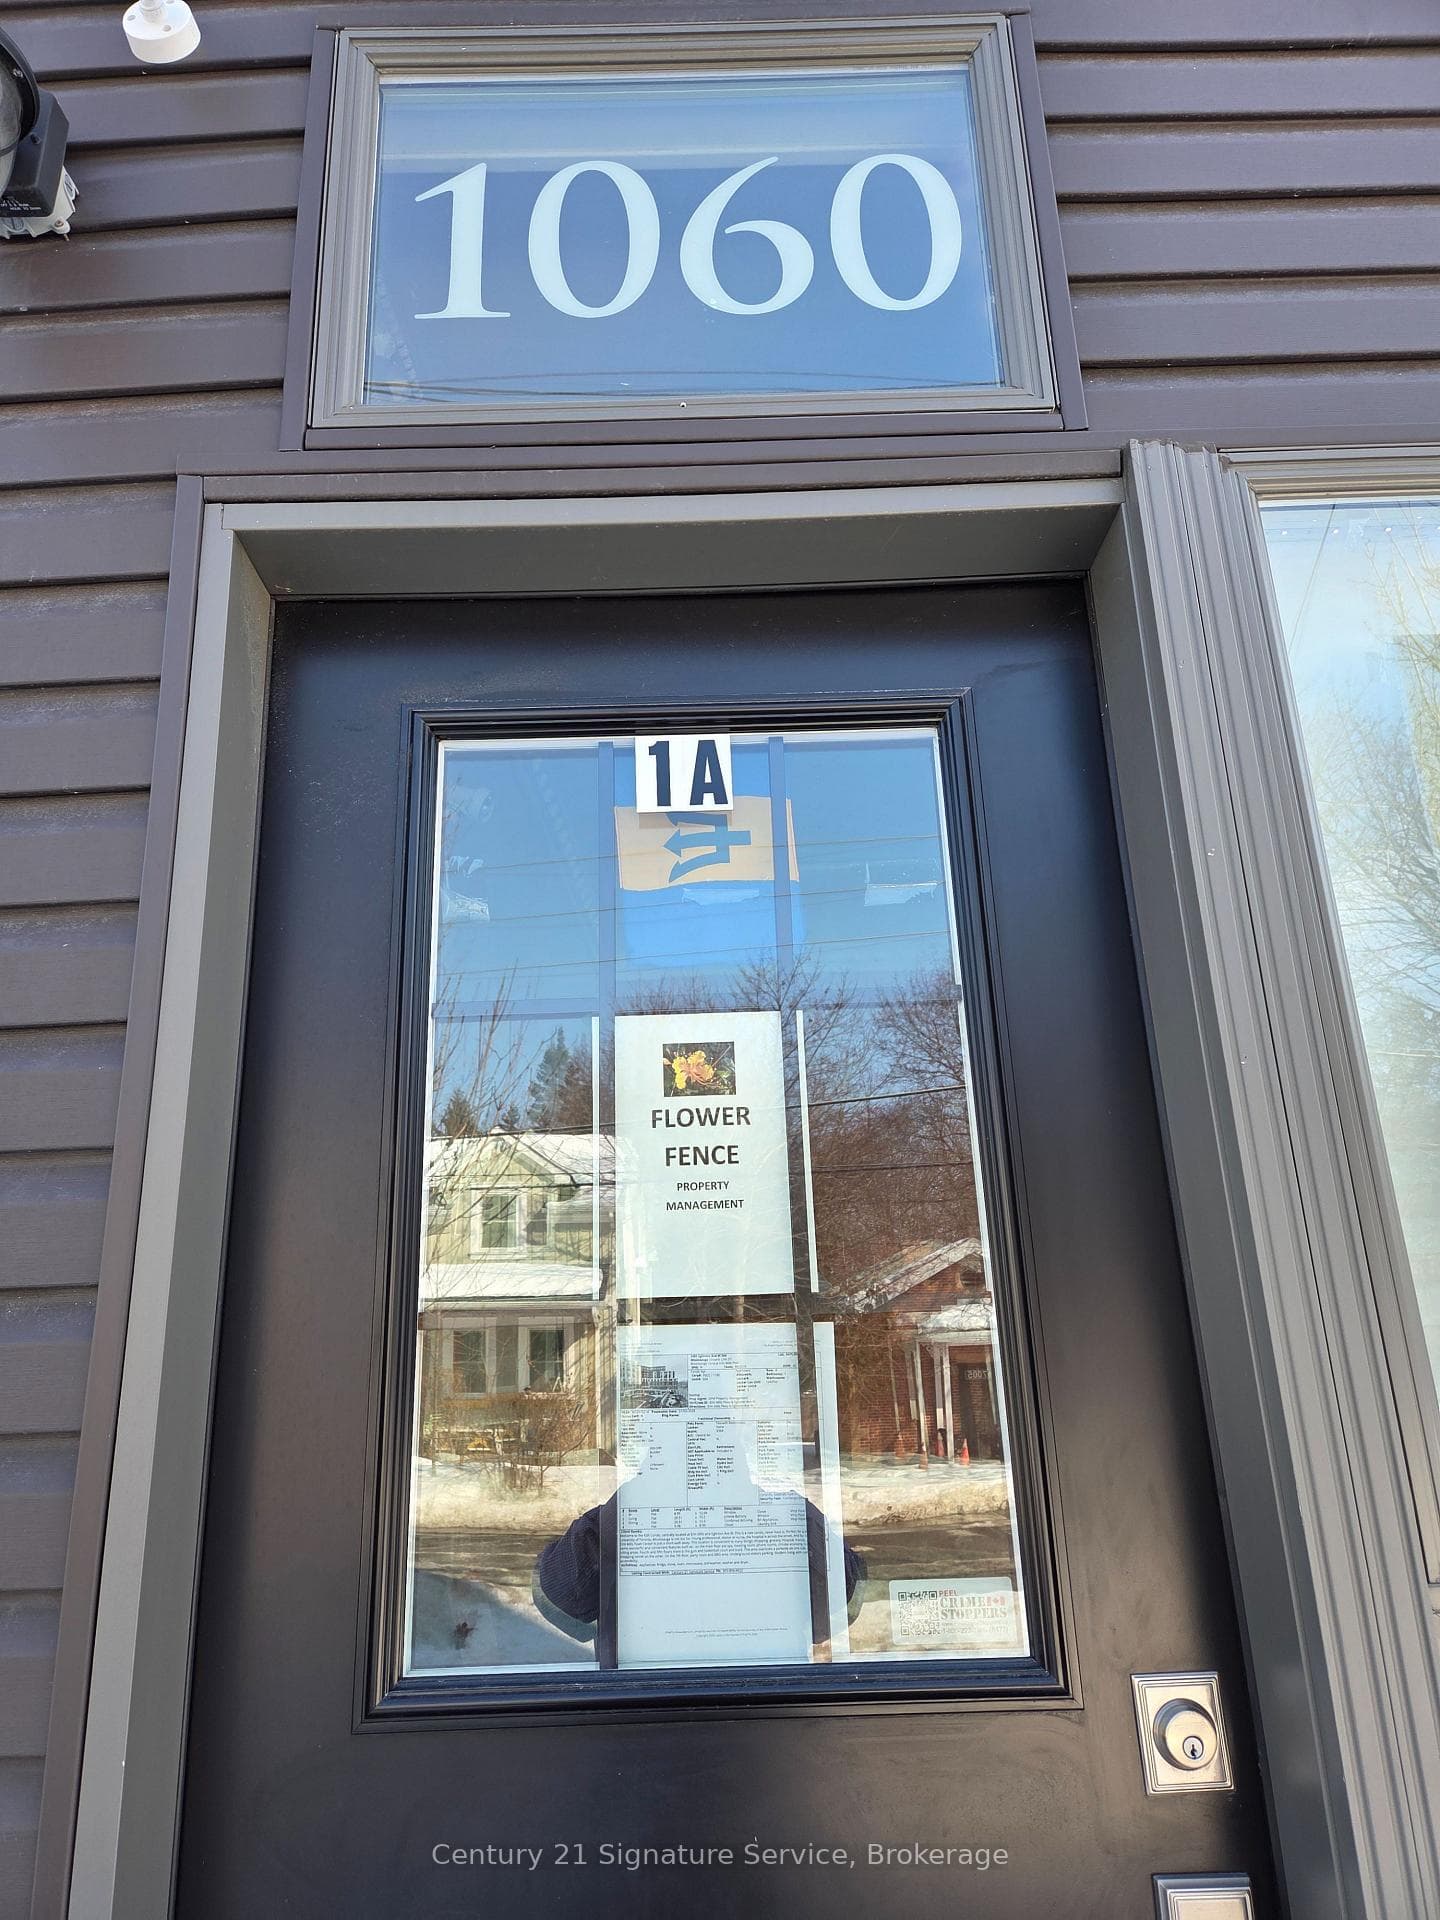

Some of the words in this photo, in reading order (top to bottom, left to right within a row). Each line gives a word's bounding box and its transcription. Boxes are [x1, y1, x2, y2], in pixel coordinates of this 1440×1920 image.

[412, 152, 963, 321] 1060
[651, 1106, 751, 1128] FLOWER
[665, 1145, 740, 1167] FENCE
[676, 1181, 730, 1192] PROPERTY
[665, 1198, 744, 1211] MANAGEMENT
[938, 1589, 958, 1597] PEEL
[940, 1596, 986, 1608] CRIME
[940, 1607, 1007, 1620] STOPPERS
